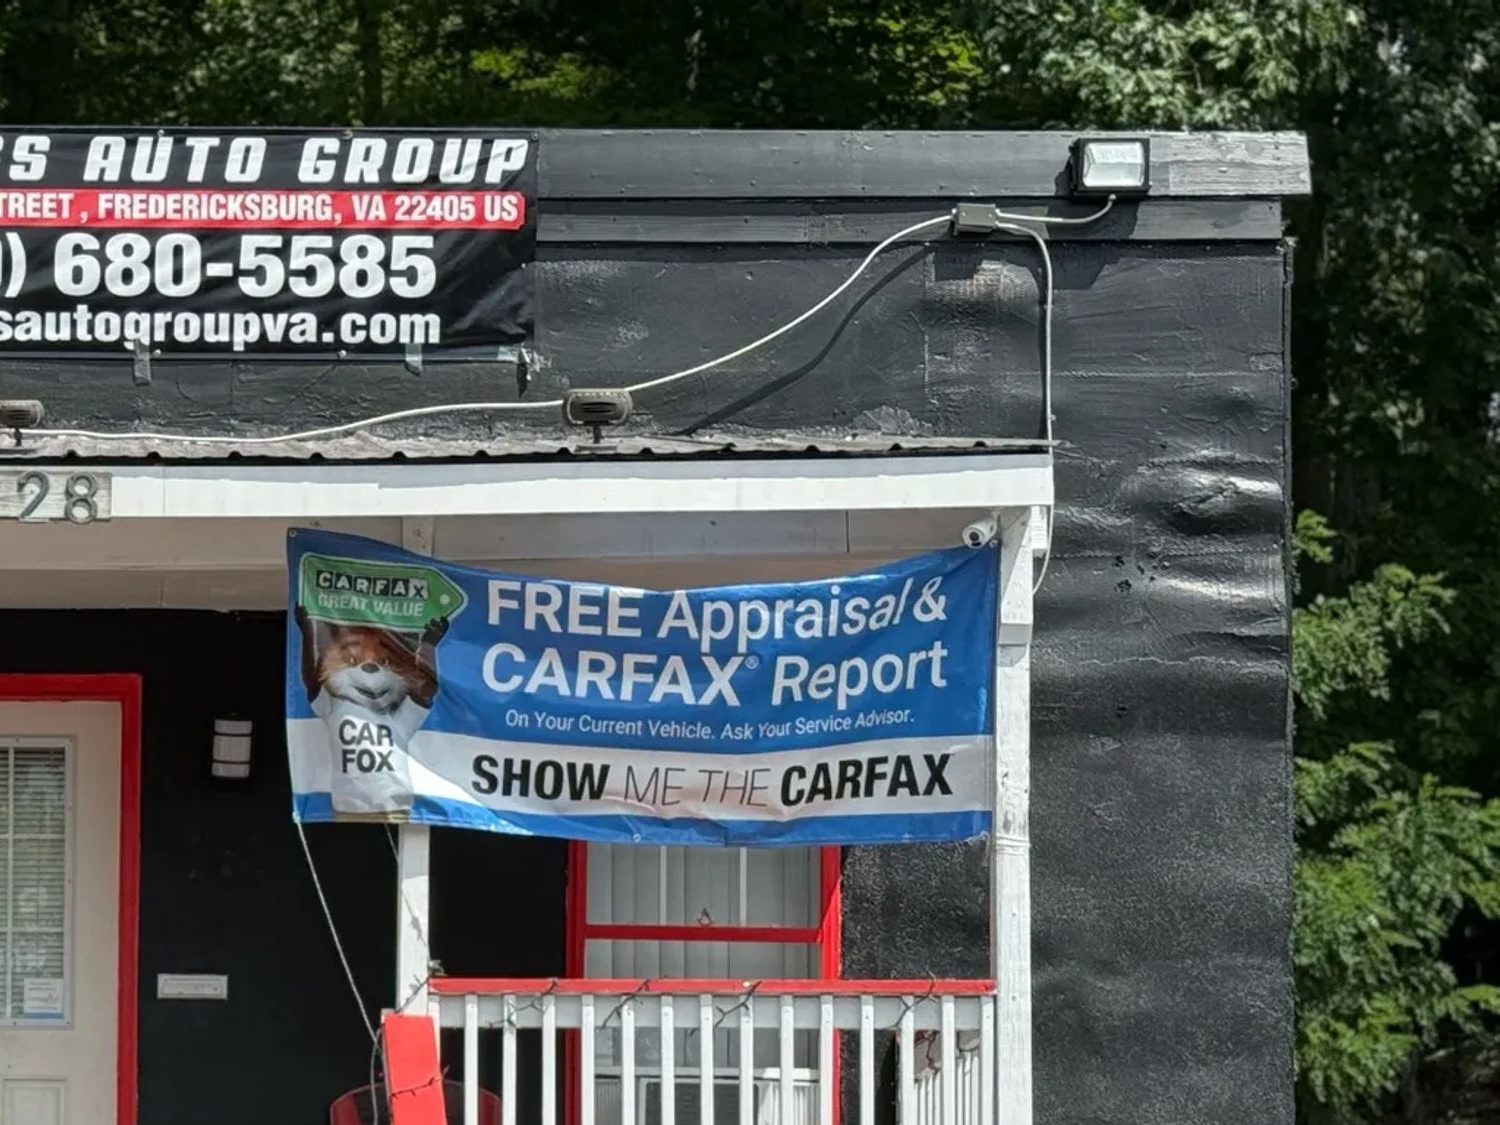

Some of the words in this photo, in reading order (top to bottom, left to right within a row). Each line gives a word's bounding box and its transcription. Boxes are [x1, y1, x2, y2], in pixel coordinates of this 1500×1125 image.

[83, 136, 267, 183] AUTO
[298, 138, 529, 185] GROUP
[98, 193, 342, 226] FREDERICKSBURG,
[352, 195, 386, 221] VA
[394, 196, 475, 222] 22405
[483, 197, 518, 222] US
[53, 233, 437, 298] 680-5585
[316, 570, 428, 599] CARFAX
[318, 592, 369, 611] GREAT
[373, 600, 425, 617] VALUE
[487, 580, 642, 638] FREE
[772, 640, 947, 710] Report
[338, 718, 394, 749] CAR
[505, 709, 529, 728] On
[534, 711, 575, 731] Your
[578, 714, 642, 736] Current
[648, 720, 716, 740] Vehicle.
[720, 723, 753, 740] Ask
[758, 722, 790, 738] Your
[795, 715, 851, 735] Service
[854, 709, 915, 728] Advisor.
[340, 747, 395, 774] FOX
[472, 754, 611, 802] SHOW
[623, 765, 685, 806] ME
[698, 767, 771, 807] THE
[780, 753, 954, 808] CARFAX
